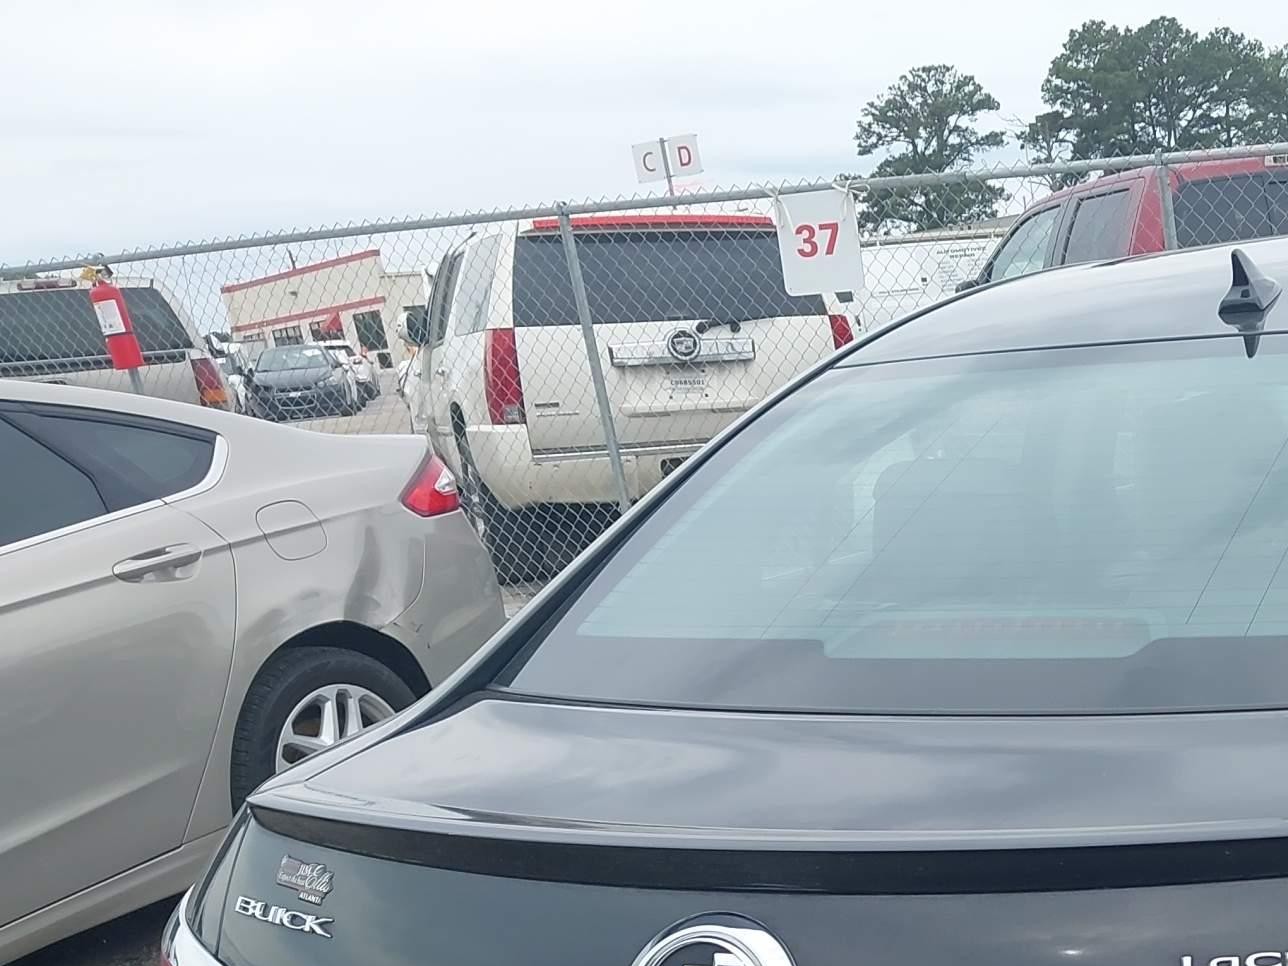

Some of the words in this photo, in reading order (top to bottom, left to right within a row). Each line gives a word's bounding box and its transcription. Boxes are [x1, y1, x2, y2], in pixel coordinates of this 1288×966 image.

[642, 151, 656, 172] C
[677, 145, 692, 167] D
[794, 222, 839, 258] 37
[234, 895, 335, 938] BUICK
